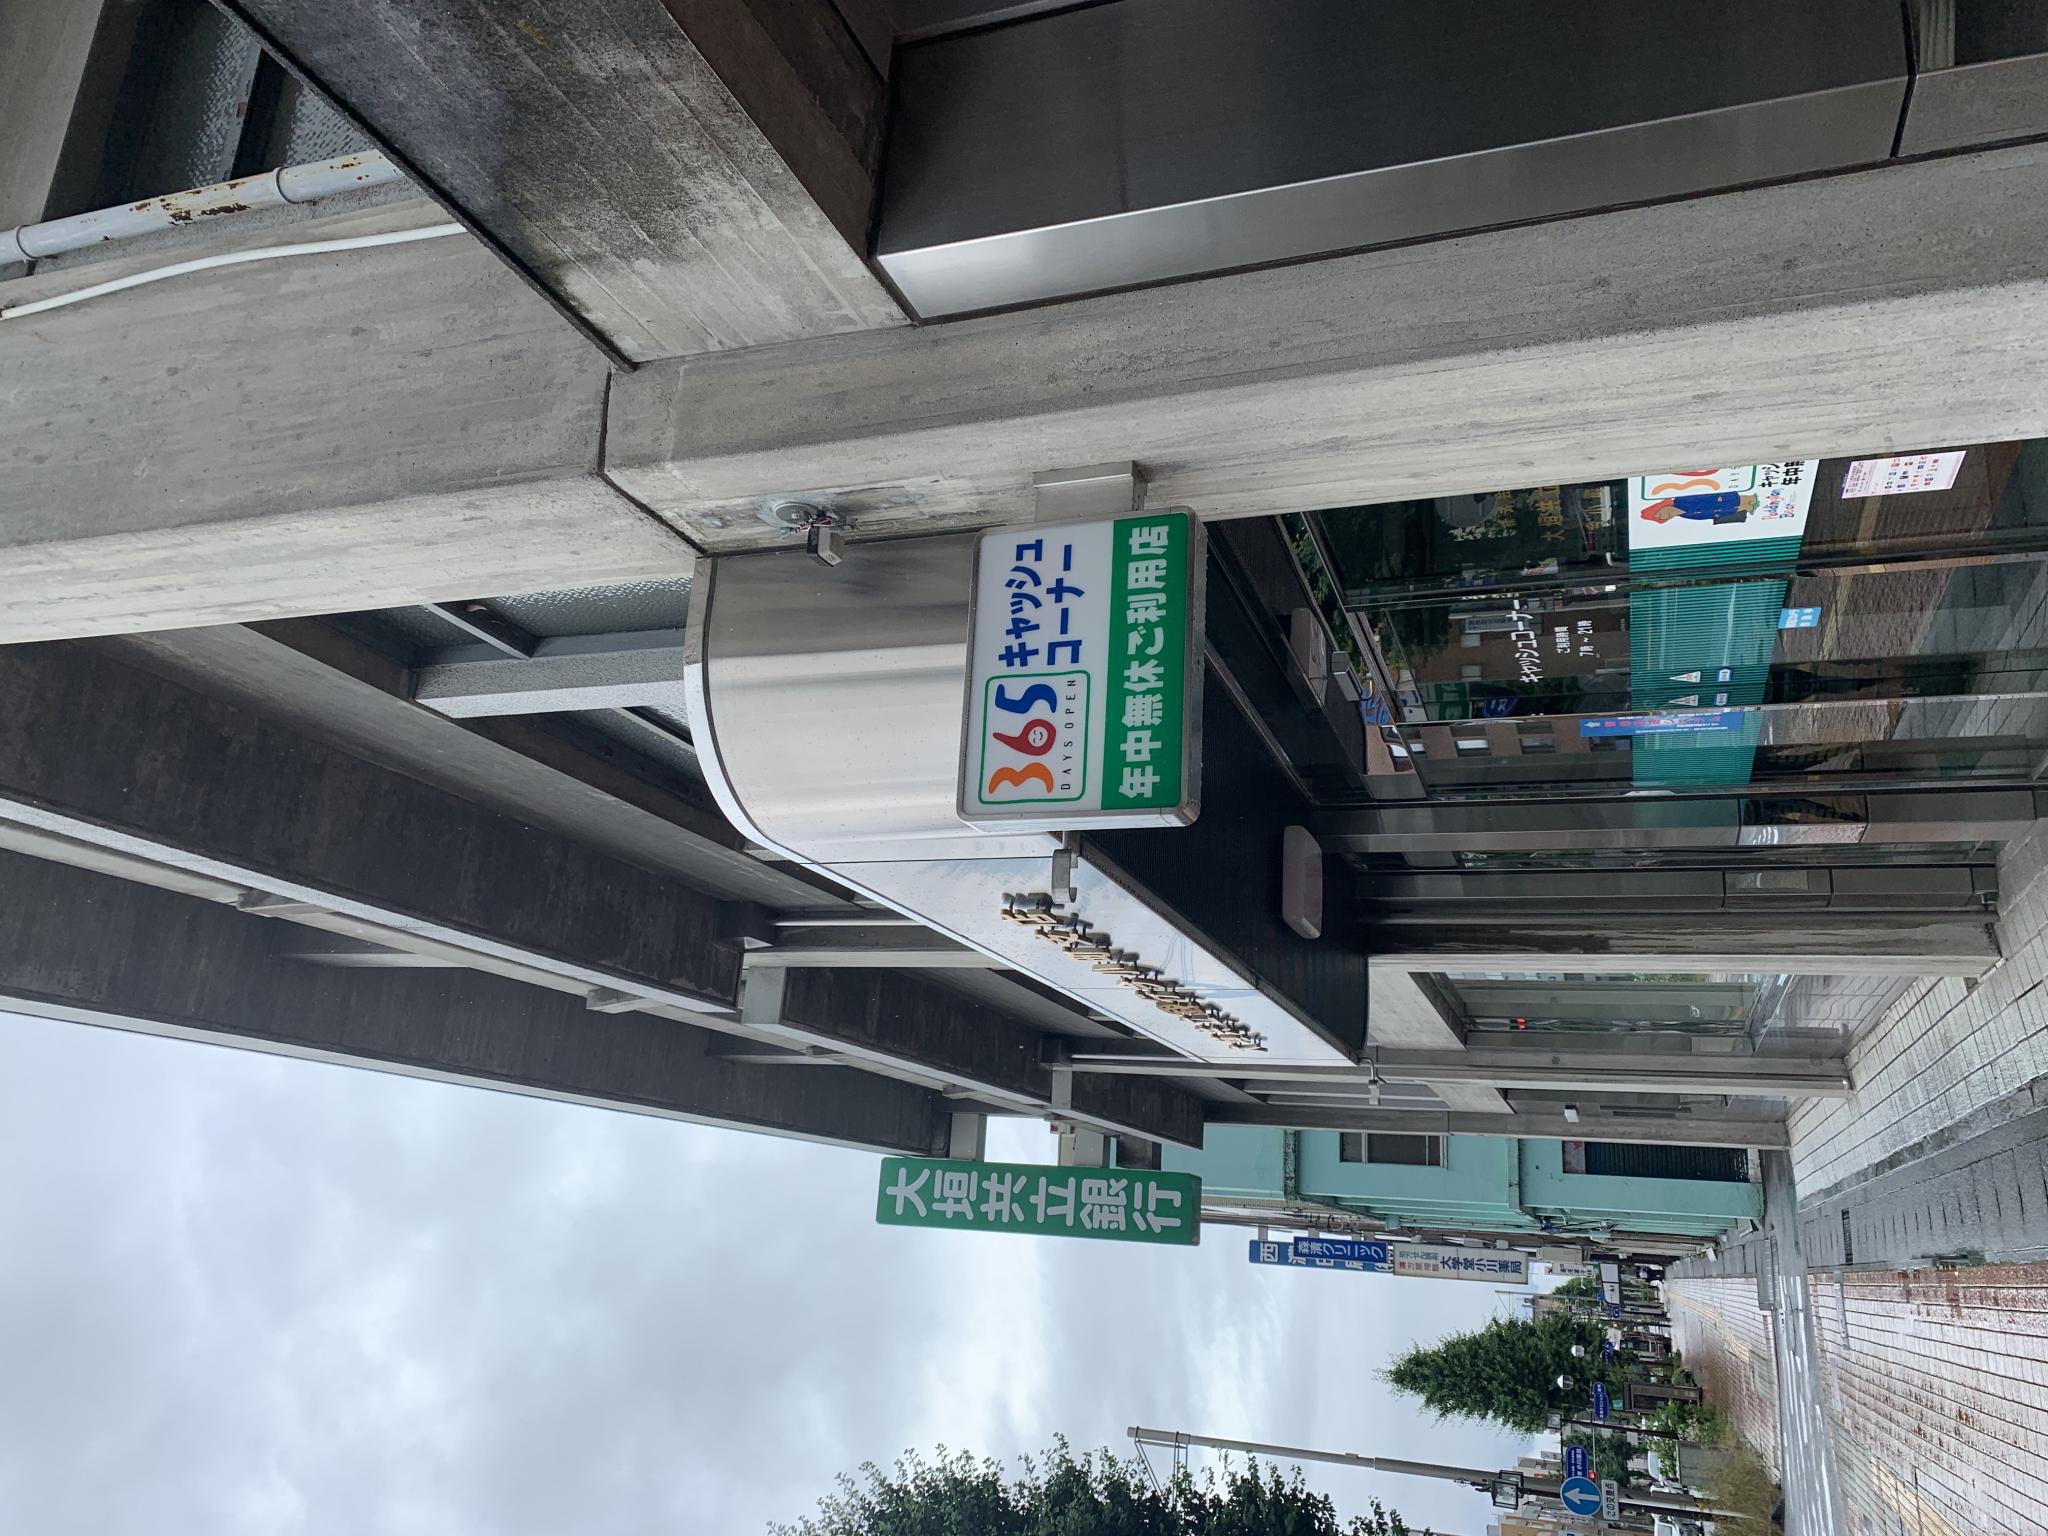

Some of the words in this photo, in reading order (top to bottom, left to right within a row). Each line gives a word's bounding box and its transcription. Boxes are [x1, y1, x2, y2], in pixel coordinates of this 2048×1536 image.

[1761, 488, 1784, 520] Paddington
[998, 538, 1043, 668] キャッシュ
[1046, 543, 1085, 666] コーナー
[1118, 524, 1169, 799] 年中無休ご利用店
[1506, 599, 1544, 683] キャッシュコーナー
[1554, 626, 1571, 654] ご利用時間
[1064, 679, 1077, 729] OPEN
[988, 683, 1057, 794] 365
[1060, 740, 1074, 790] DAYS
[886, 1167, 1182, 1233] 大垣共立銀行
[1297, 1240, 1384, 1259] 森清クリニック
[1440, 1255, 1522, 1275] 大学堂小川薬局
